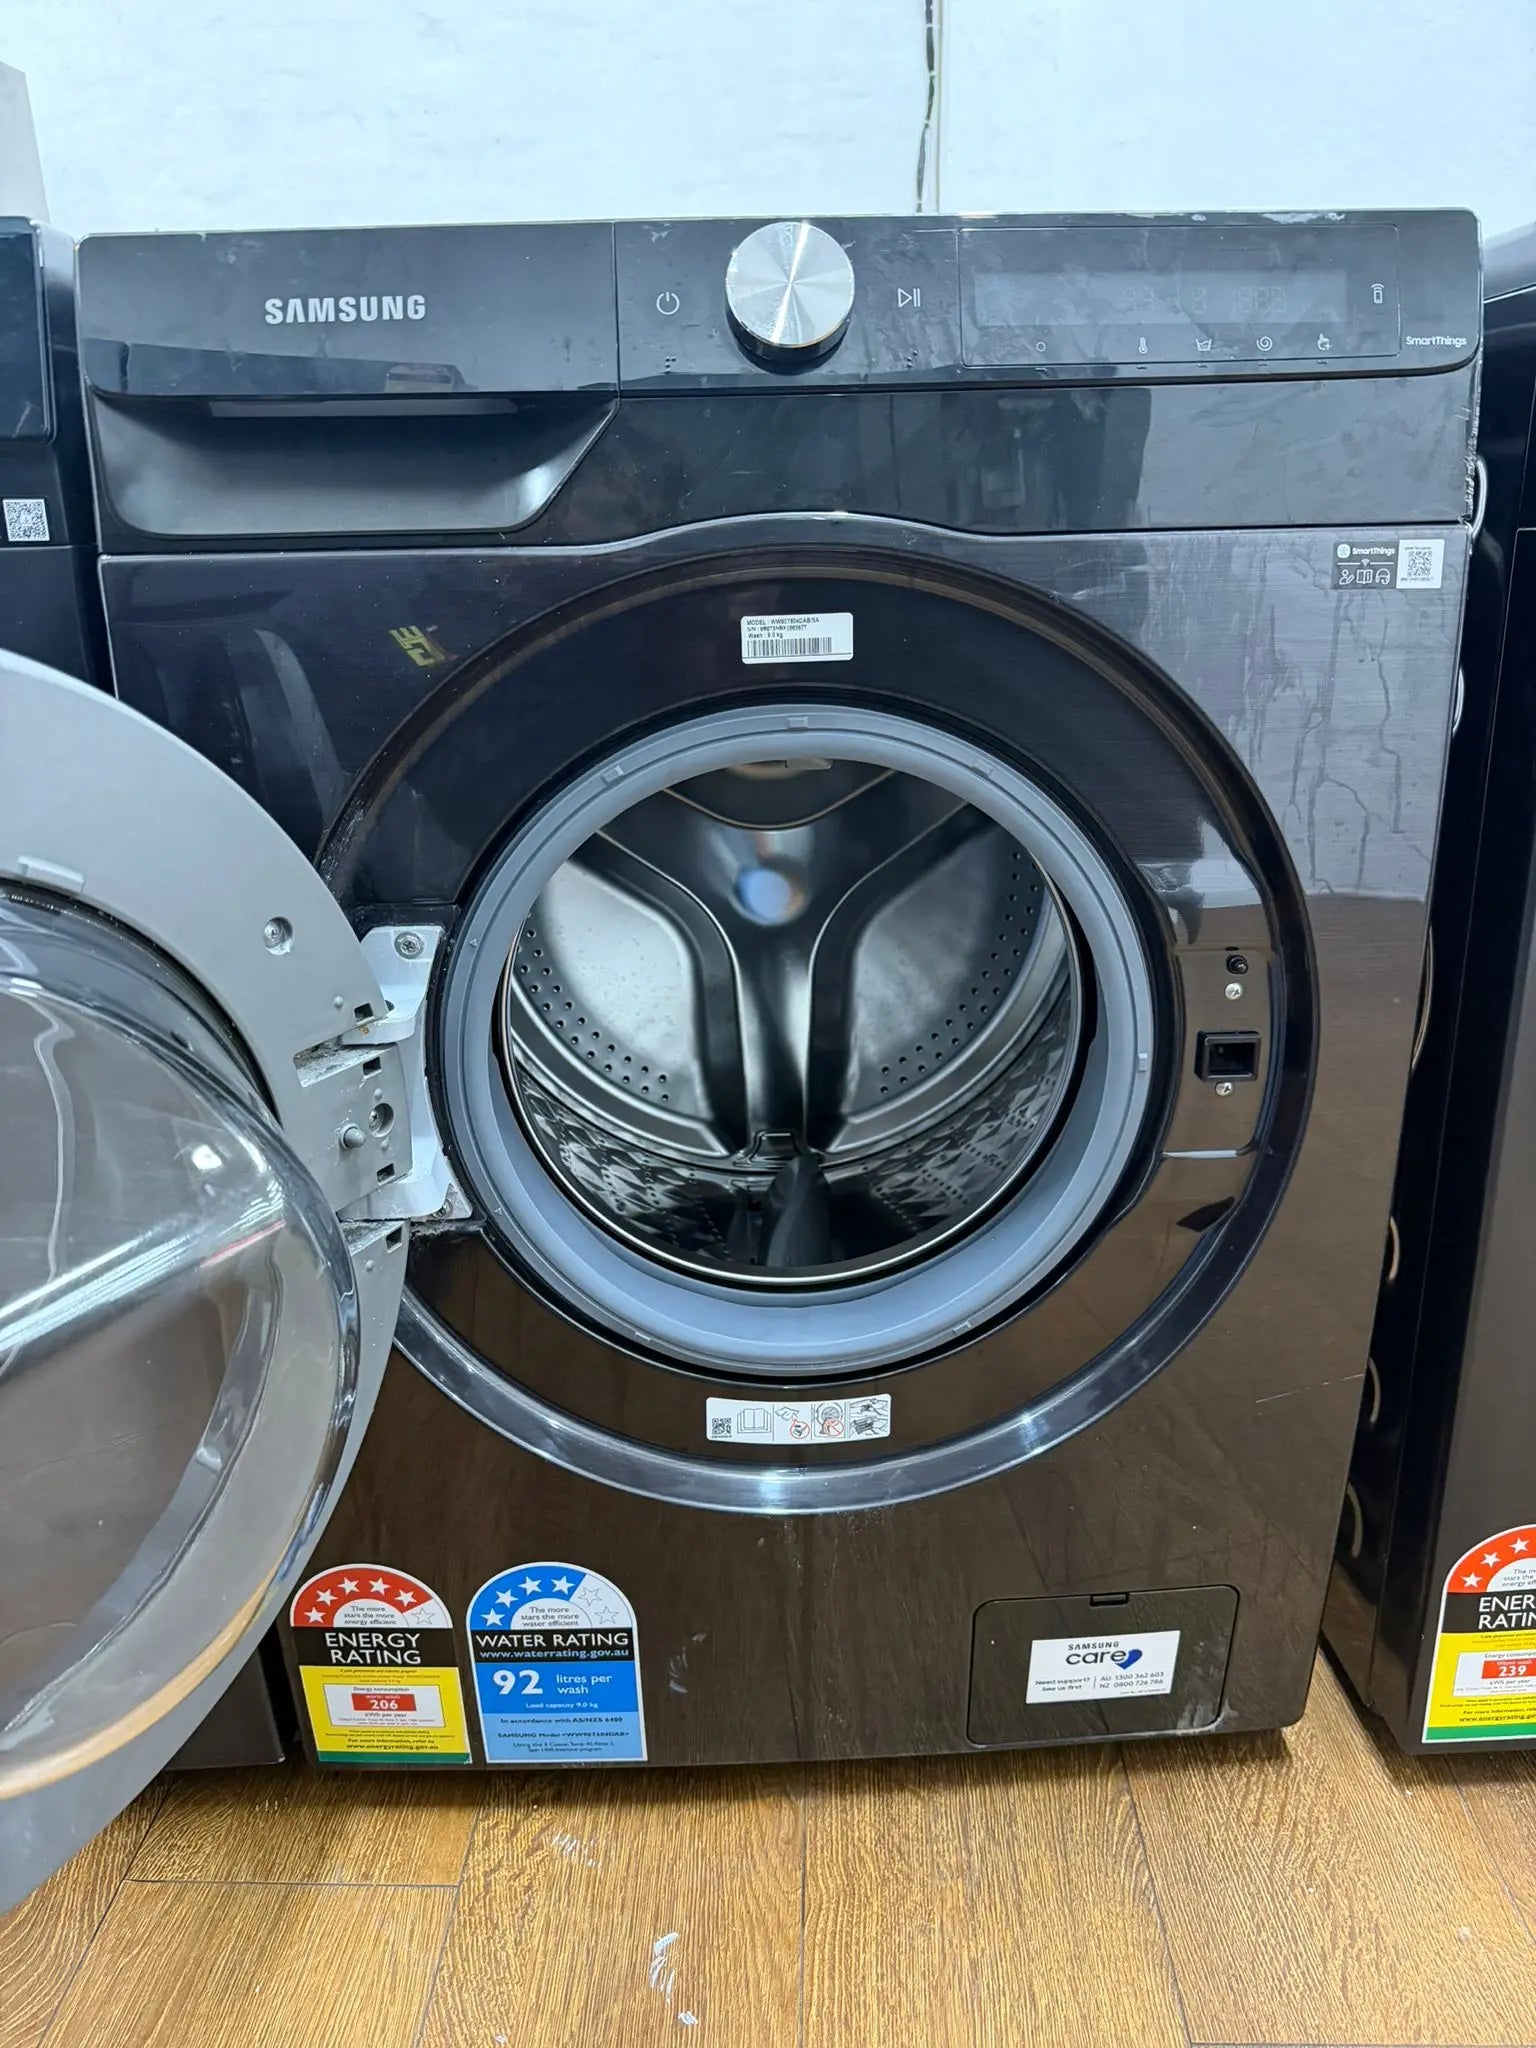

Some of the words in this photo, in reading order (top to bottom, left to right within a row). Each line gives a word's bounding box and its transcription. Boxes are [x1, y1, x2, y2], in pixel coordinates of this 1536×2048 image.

[264, 294, 426, 325] SAMSUNG
[1406, 335, 1468, 348] SmartThings
[1351, 546, 1396, 557] SmartThings
[1501, 1580, 1527, 1588] energy
[1503, 1574, 1520, 1582] stars
[1479, 1594, 1536, 1612] ENER
[548, 1619, 579, 1627] efficient
[324, 1632, 421, 1648] ENERGY
[475, 1634, 547, 1648] WATER
[552, 1632, 629, 1647] RATING
[1067, 1641, 1120, 1651] SAMSUNG
[330, 1649, 421, 1665] RATING
[479, 1648, 629, 1660] www.waterrating.gov.au
[1065, 1649, 1127, 1666] care
[1498, 1664, 1527, 1677] 239
[493, 1669, 544, 1695] 92
[556, 1674, 588, 1684] litres
[590, 1674, 613, 1686] per
[1115, 1673, 1133, 1681] 1300
[557, 1684, 589, 1695] wash
[370, 1699, 399, 1711] 206
